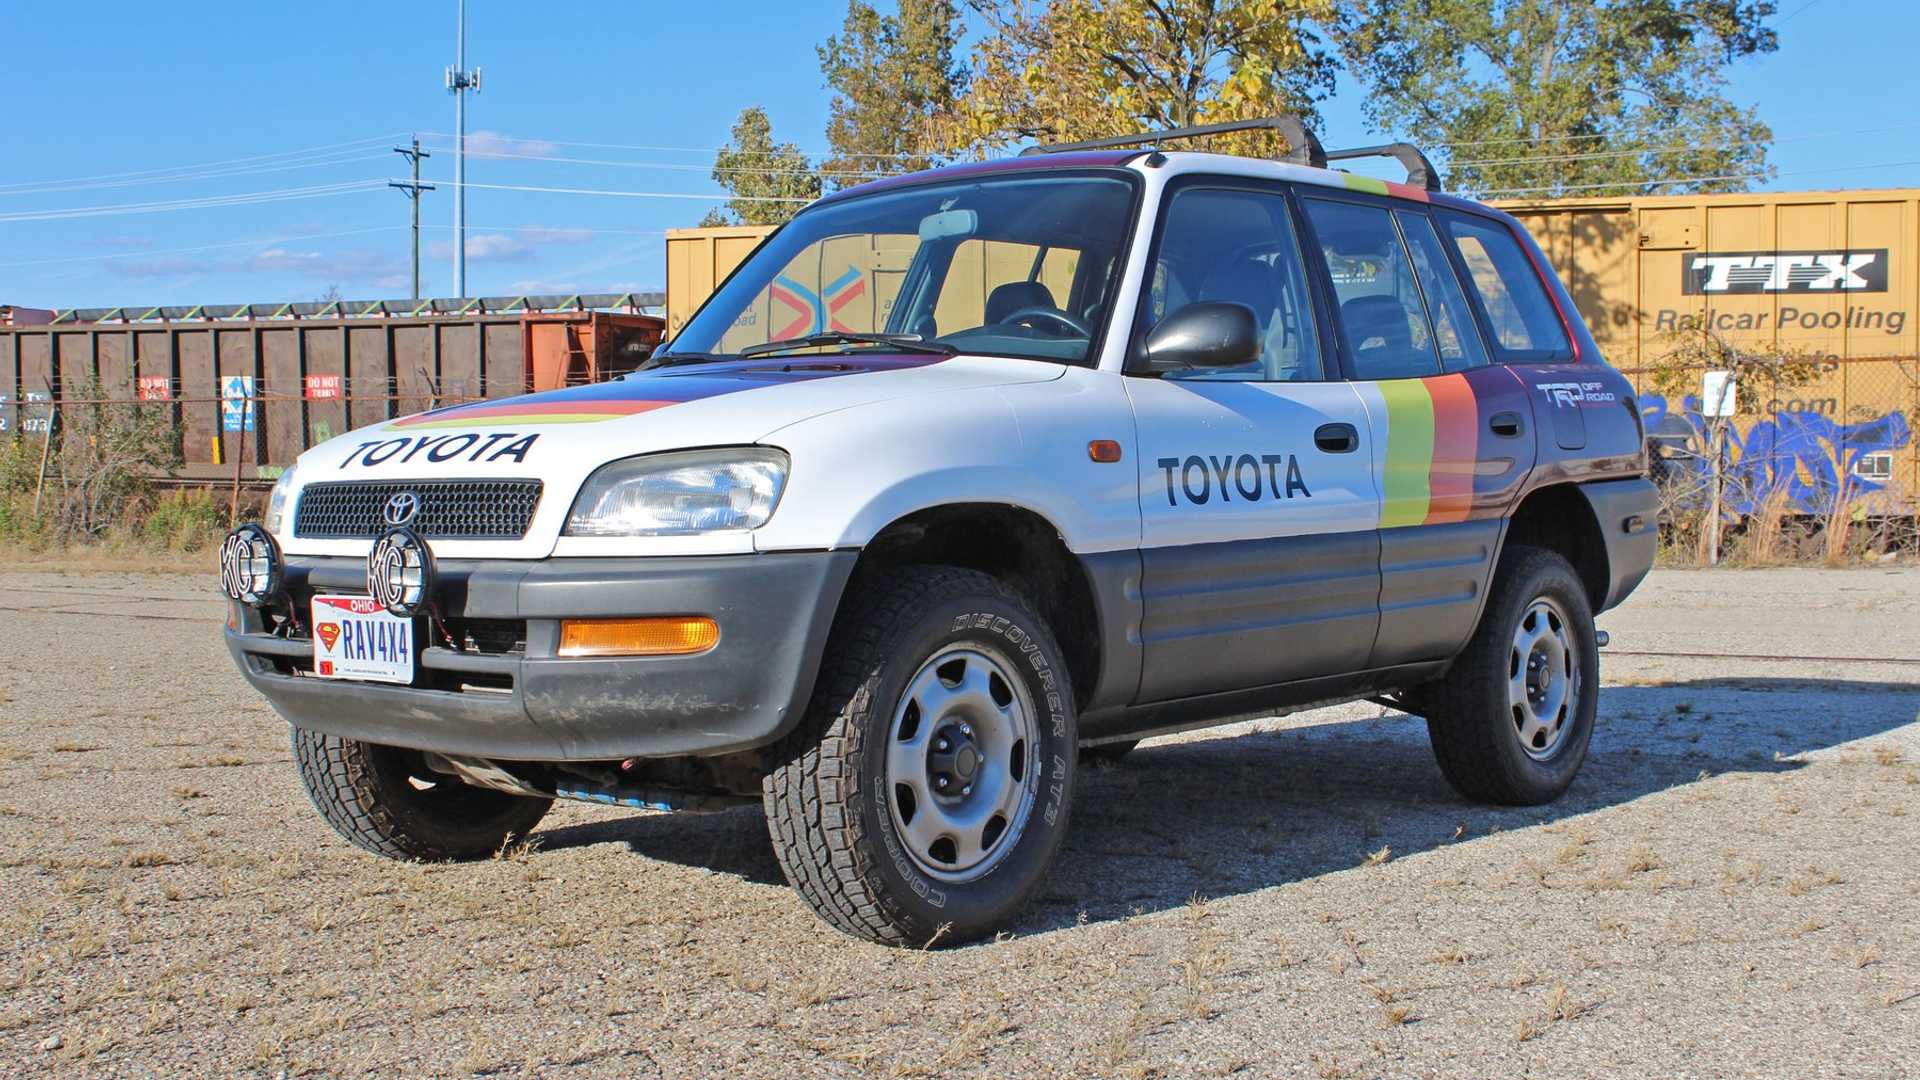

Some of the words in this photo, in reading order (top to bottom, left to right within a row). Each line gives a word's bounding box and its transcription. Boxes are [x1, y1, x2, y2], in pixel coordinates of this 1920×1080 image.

[1691, 253, 1876, 291] TTX
[1655, 308, 1768, 332] Railcar
[1777, 305, 1906, 335] Pooling
[307, 376, 320, 388] DO
[322, 376, 340, 388] NOT
[1536, 383, 1584, 408] TRD
[1581, 382, 1603, 391] OFF
[1586, 393, 1616, 401] ROAD
[339, 433, 541, 470] TOYOTA
[1157, 453, 1312, 507] TOYOTA
[219, 535, 252, 599] KC
[367, 539, 404, 608] KC
[350, 600, 375, 612] OHIO
[342, 619, 409, 664] RAV4X4
[952, 612, 1067, 738] DISCOVERER
[874, 775, 946, 908] COOPER
